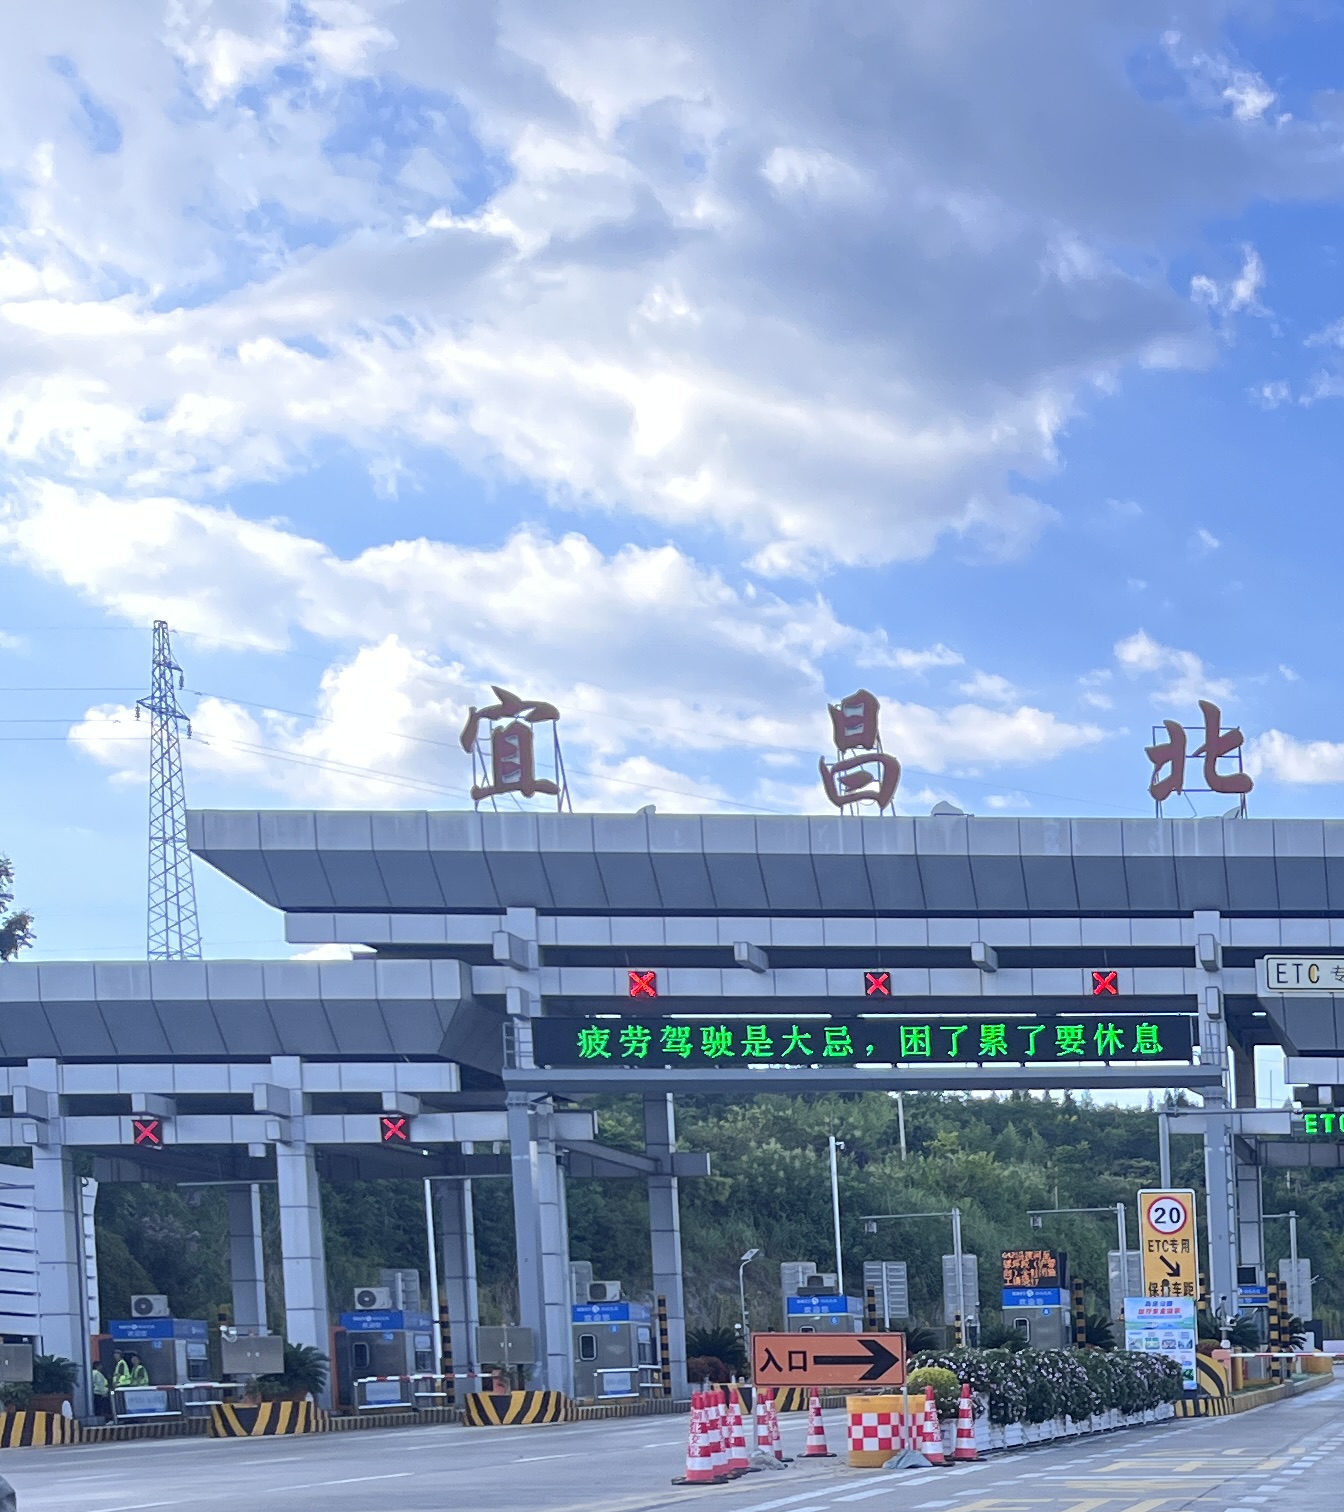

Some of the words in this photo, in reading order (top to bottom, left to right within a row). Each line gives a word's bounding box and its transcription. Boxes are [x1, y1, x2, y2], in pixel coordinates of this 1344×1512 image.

[460, 686, 1255, 809] 宜昌北
[1276, 963, 1320, 984] ETC
[576, 1022, 1164, 1062] 疲劳驾驶是大忌，困了累了要休息
[1154, 1207, 1181, 1224] 20
[1147, 1238, 1190, 1253] ETC专用
[759, 1347, 808, 1373] 入口
